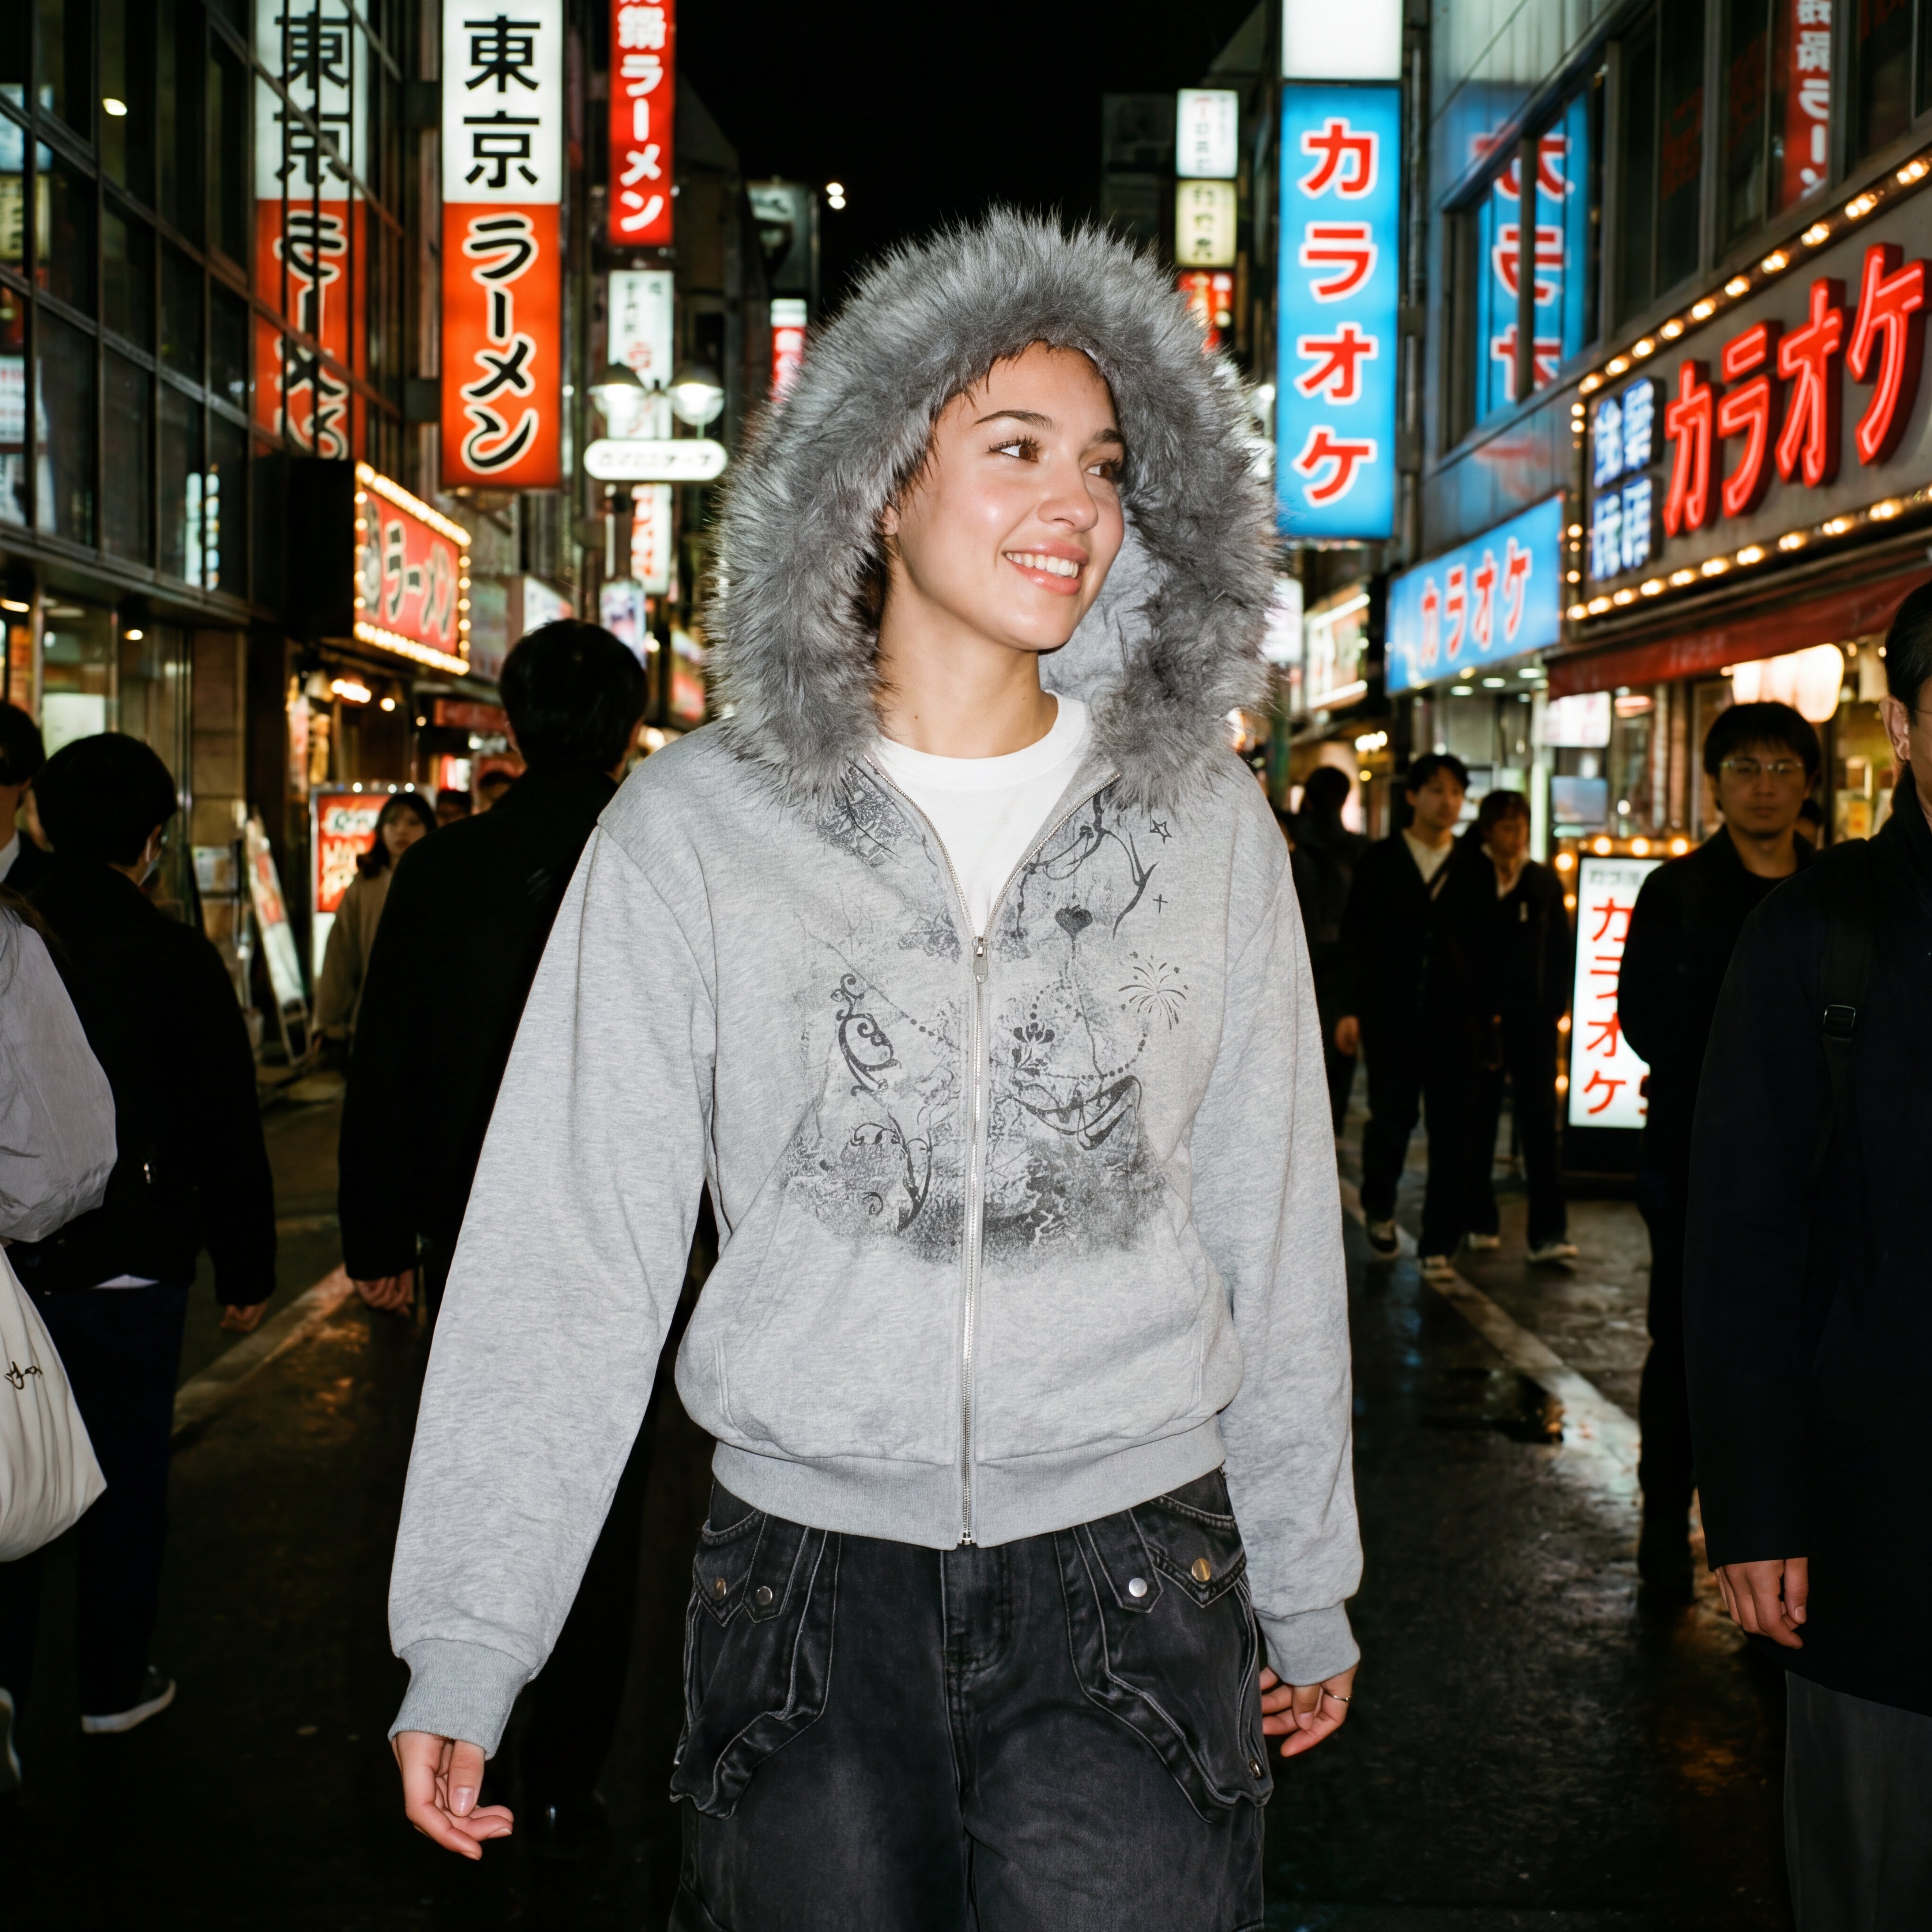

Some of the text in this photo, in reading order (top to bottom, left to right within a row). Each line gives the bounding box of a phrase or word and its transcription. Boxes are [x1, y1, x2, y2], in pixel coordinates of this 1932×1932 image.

[464, 14, 541, 188] 東京
[462, 211, 539, 474] ラーメン
[1293, 118, 1379, 507] カラオケ
[1662, 242, 1925, 539] カラオケ
[1421, 538, 1532, 667] カラオケ
